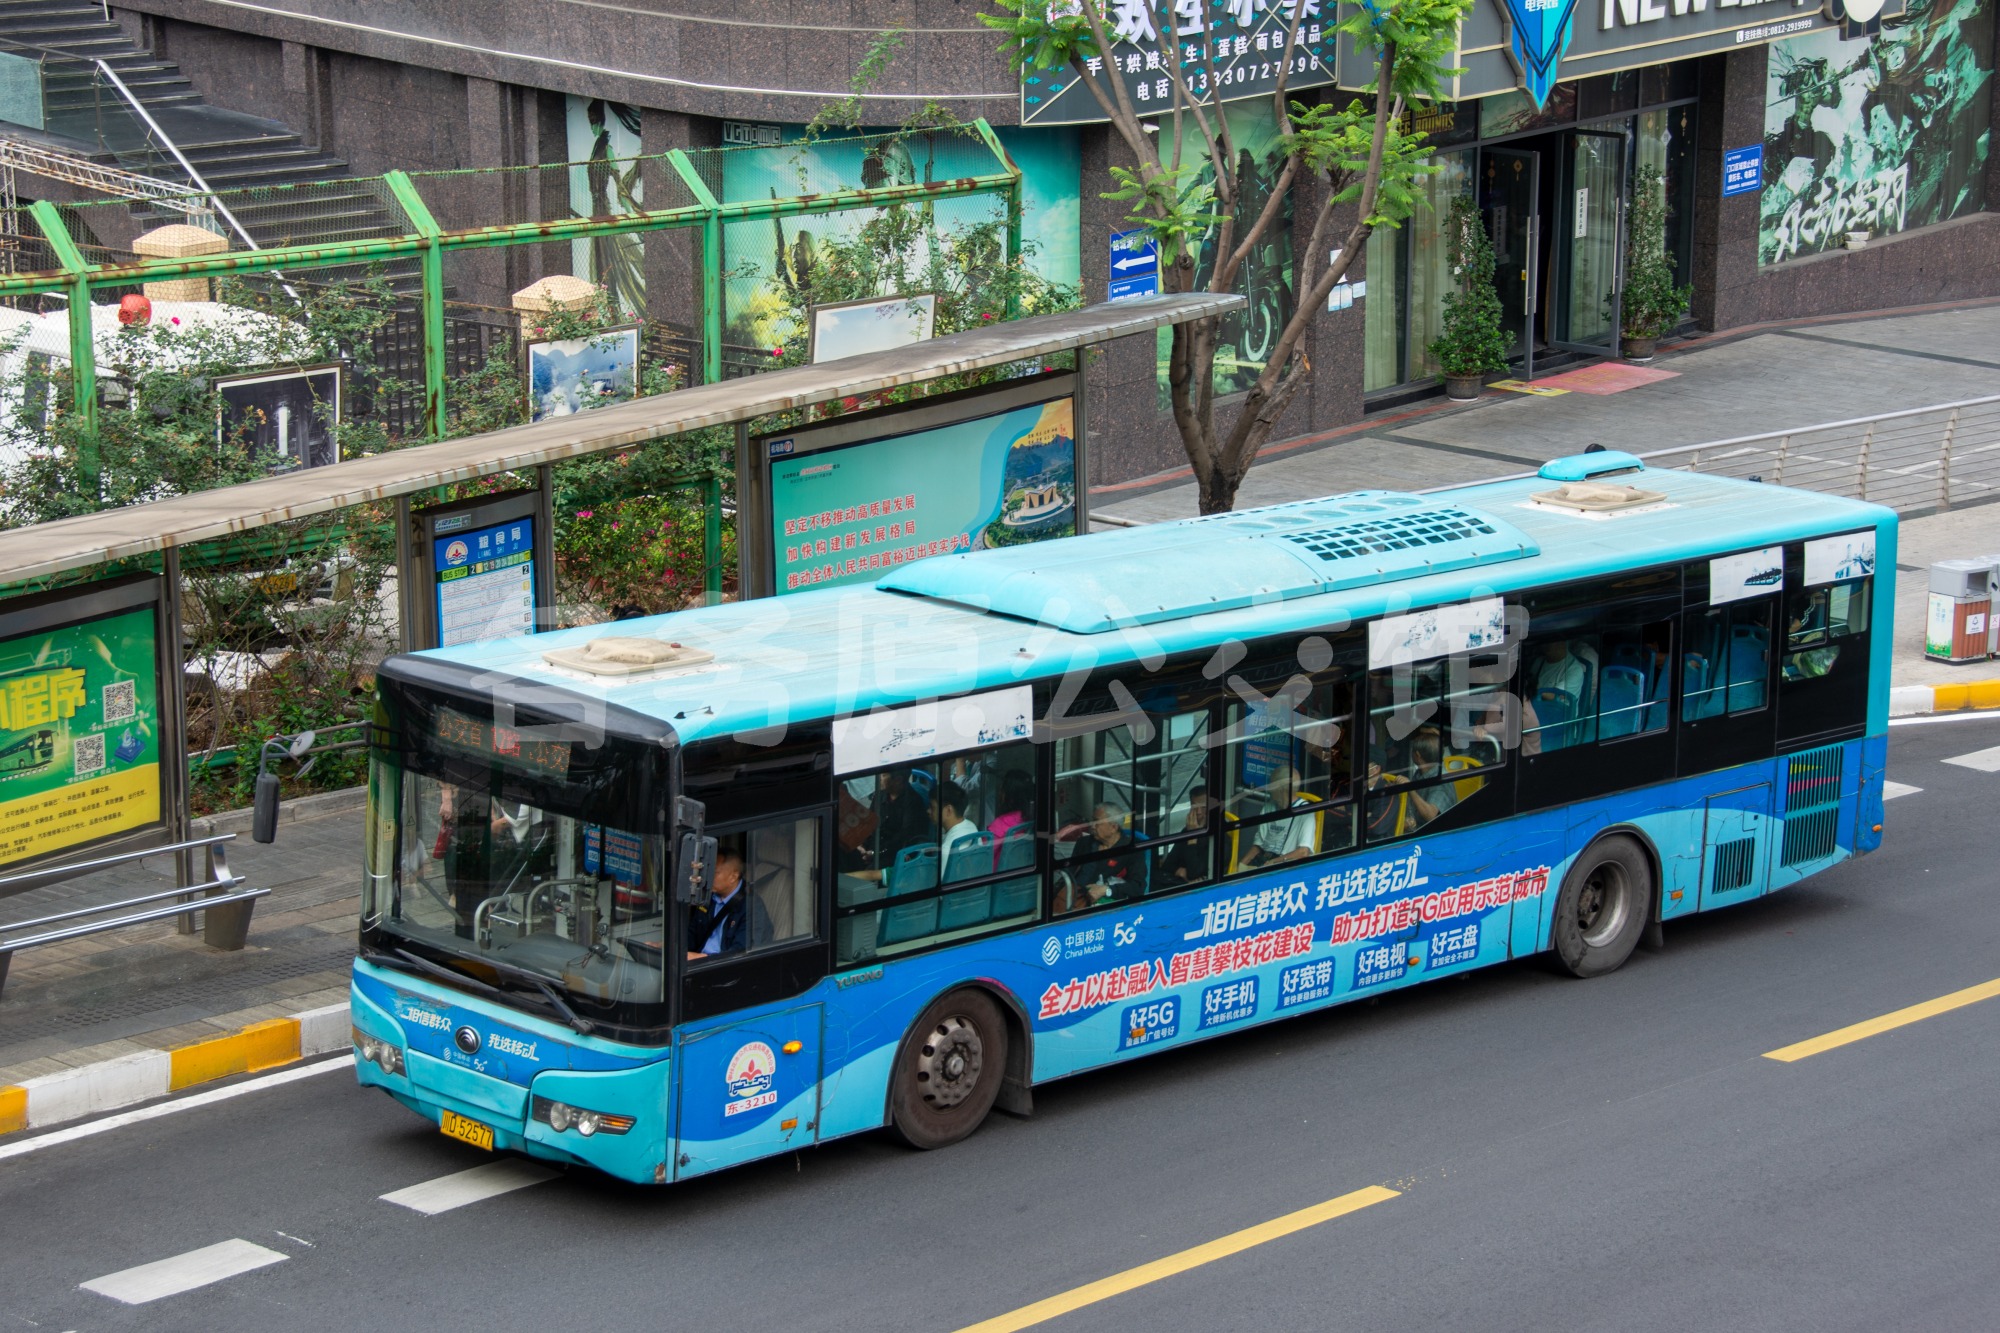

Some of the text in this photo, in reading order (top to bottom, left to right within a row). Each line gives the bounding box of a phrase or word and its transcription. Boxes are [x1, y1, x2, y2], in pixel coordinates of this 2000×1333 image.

[1137, 78, 1170, 101] 电话
[785, 494, 916, 536] 坚定不移推动高质量发展
[787, 520, 916, 562] 加快构建新发展格局
[443, 567, 467, 580] BUS STOP
[787, 532, 971, 590] 推动全体人民共同富裕迈出坚实步伐
[1184, 853, 1429, 941] 相信群众 我选移动
[1331, 866, 1551, 946] 助力打造5G应用示范城市
[1064, 927, 1105, 949] 中国移动
[1065, 943, 1105, 960] China Mobile
[1431, 924, 1478, 957] 好云盘
[1038, 920, 1315, 1021] 全力以赴融入智慧攀枝花建设
[1357, 941, 1406, 976] 好电视
[1431, 949, 1476, 968] 更加安全不限速
[836, 969, 884, 989] YUTONG
[1282, 959, 1333, 996] 好宽带
[1358, 968, 1404, 986] 内容更多更新快
[1204, 980, 1256, 1015] 好手机
[1283, 987, 1329, 1007] 更快更稳服务优
[1129, 1001, 1175, 1030] 好5G
[1205, 1006, 1253, 1027] 大牌新机优惠多
[400, 1006, 540, 1062] 相信群众 我选移动
[727, 1092, 776, 1115] 东-3210
